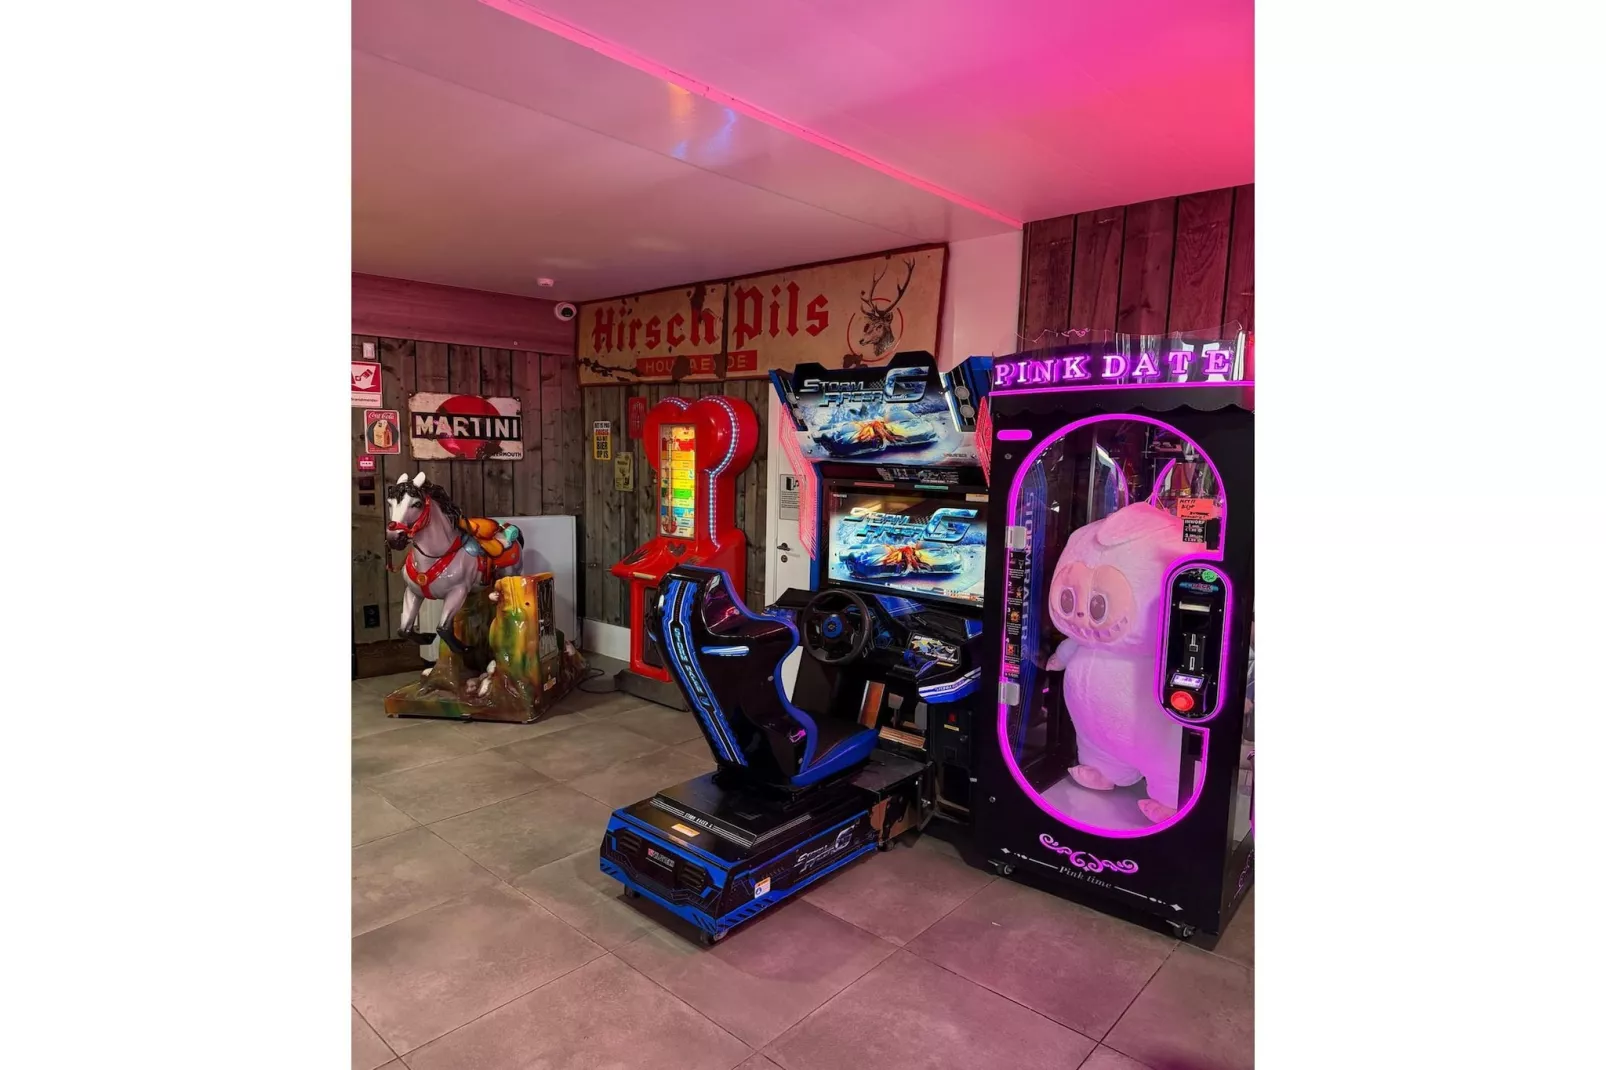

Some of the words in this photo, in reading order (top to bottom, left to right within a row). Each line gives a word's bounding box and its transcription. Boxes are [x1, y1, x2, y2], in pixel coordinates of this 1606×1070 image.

[592, 303, 719, 353] Hirsch
[733, 281, 829, 350] Pils
[645, 354, 747, 373] HOUAEDE
[994, 356, 1090, 385] PINK
[1102, 350, 1231, 378] DATE
[800, 379, 864, 392] STORM
[415, 415, 519, 438] MARTINI
[1059, 866, 1084, 880] Pink
[1086, 875, 1112, 888] time
